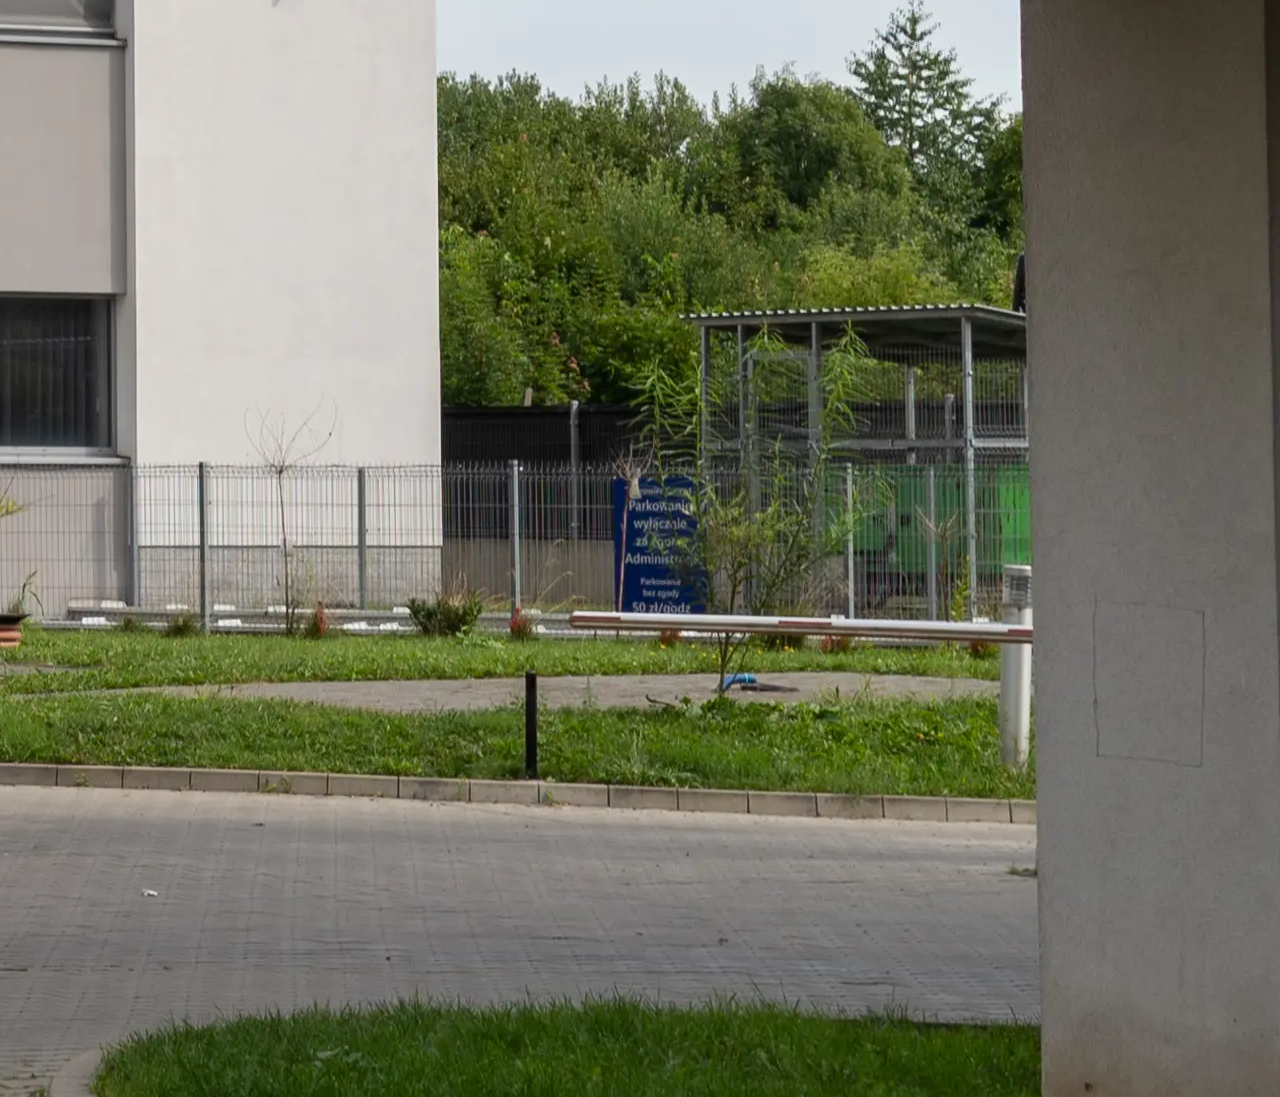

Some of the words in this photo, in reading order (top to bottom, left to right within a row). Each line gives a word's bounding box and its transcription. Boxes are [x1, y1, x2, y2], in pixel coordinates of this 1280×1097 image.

[640, 577, 681, 586] Parkowanie
[642, 588, 656, 597] bez
[657, 589, 680, 599] zgody
[632, 602, 646, 613] 50
